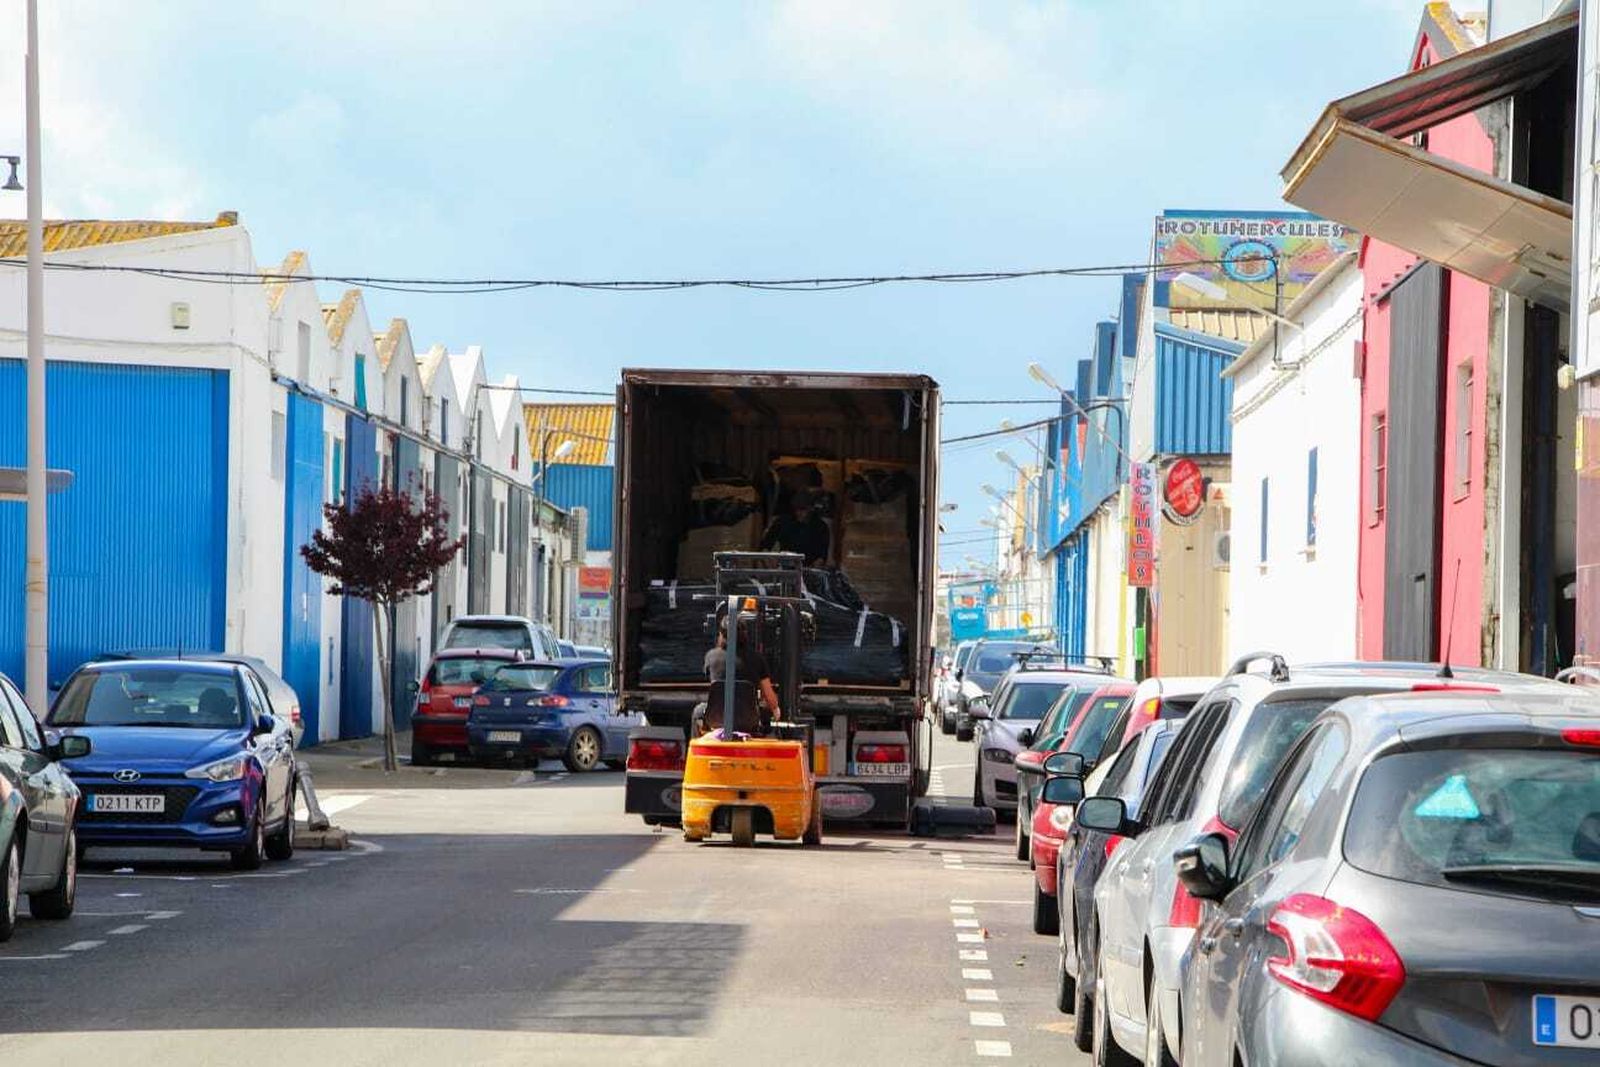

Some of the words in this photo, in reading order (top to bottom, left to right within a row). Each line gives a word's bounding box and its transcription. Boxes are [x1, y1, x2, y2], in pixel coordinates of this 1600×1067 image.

[1164, 219, 1340, 237] ROTUHERCULES
[96, 797, 130, 810] 0211
[134, 797, 161, 810] KTP
[1570, 1003, 1600, 1040] 0
[1541, 1023, 1551, 1036] E
